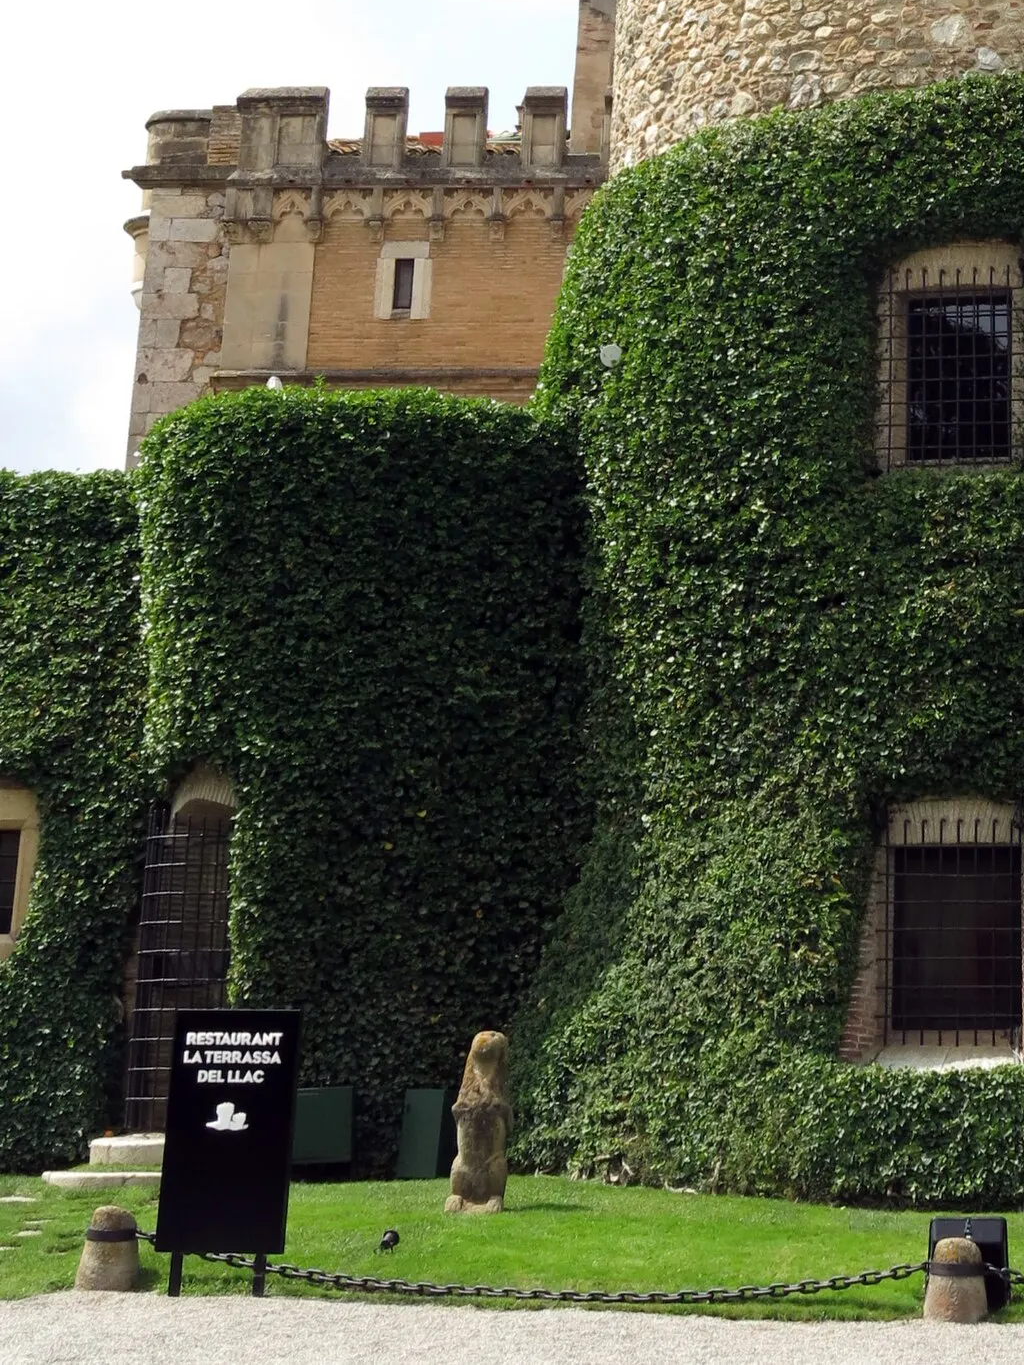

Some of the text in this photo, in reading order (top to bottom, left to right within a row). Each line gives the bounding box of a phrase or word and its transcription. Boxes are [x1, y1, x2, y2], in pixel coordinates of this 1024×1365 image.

[186, 1031, 284, 1046] RESTAURANT
[183, 1050, 282, 1064] LA TERRASSA
[197, 1069, 265, 1083] DEL LLAC
